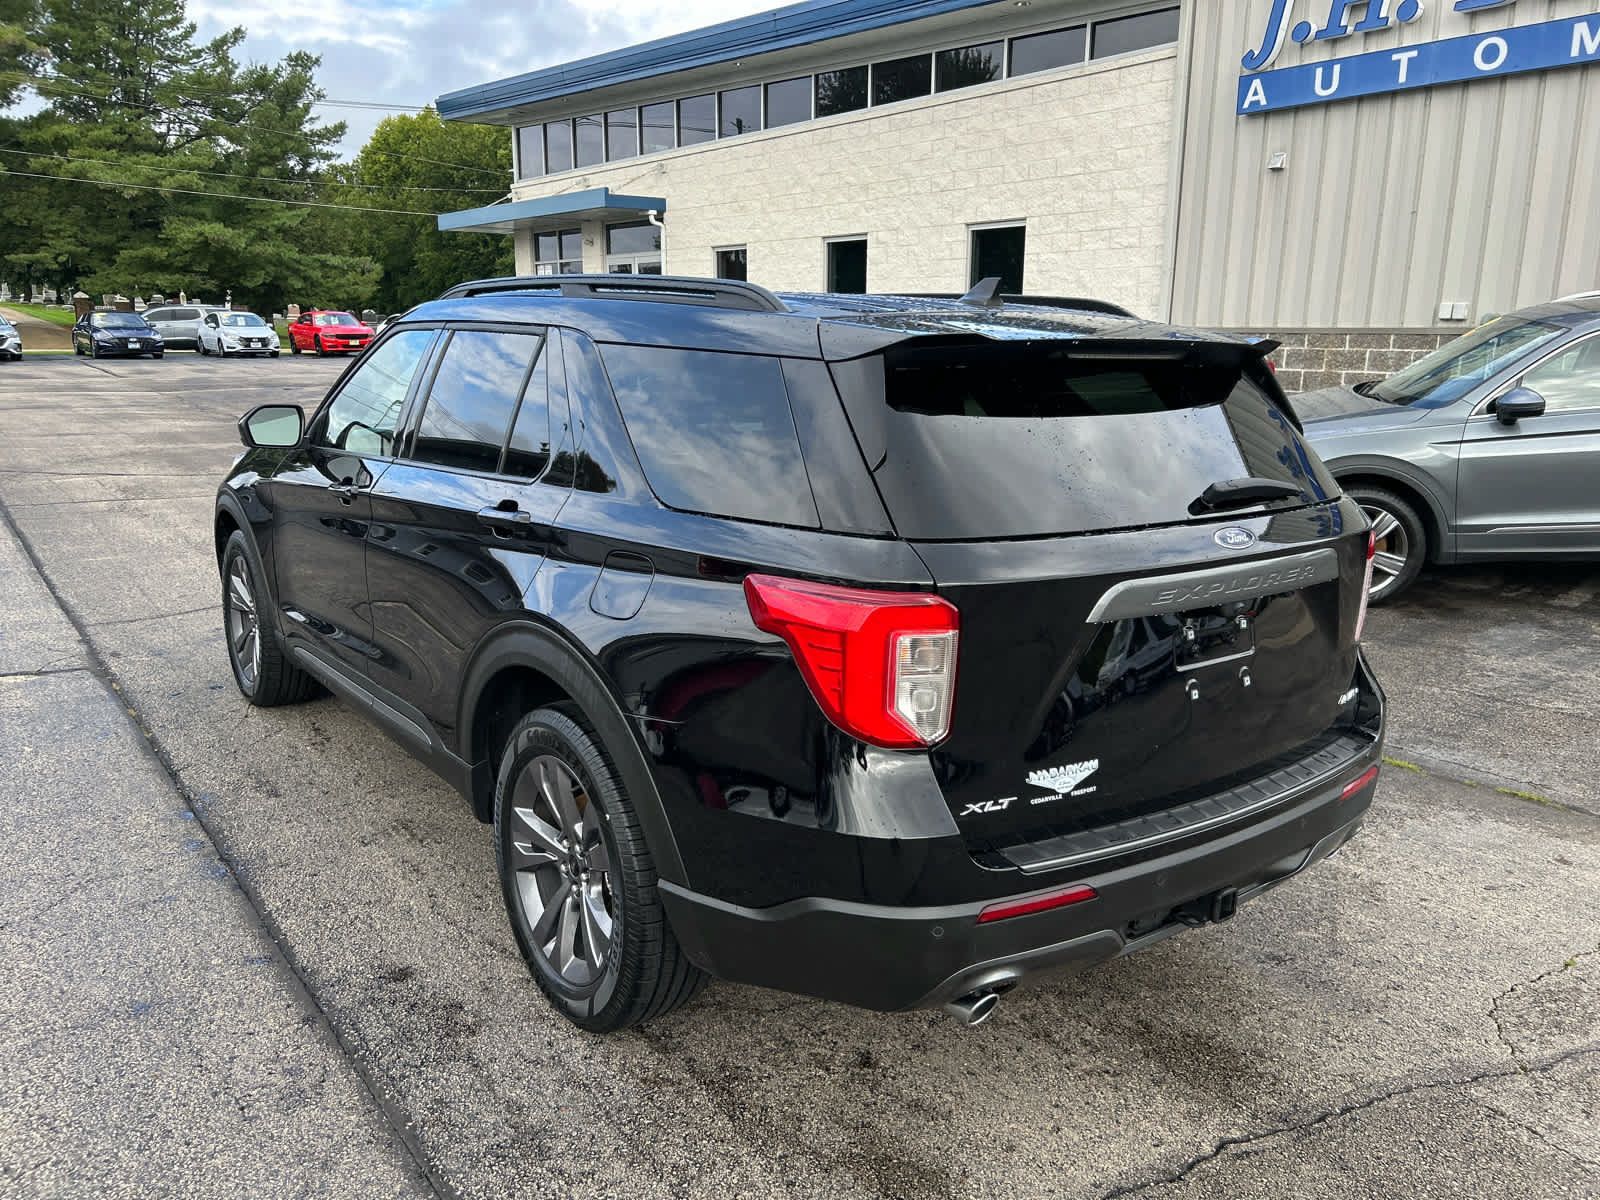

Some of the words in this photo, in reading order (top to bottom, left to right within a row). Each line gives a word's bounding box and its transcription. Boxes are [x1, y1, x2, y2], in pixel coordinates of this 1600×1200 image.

[1151, 565, 1315, 606] EXPLORER
[959, 796, 1018, 816] XLT
[1030, 793, 1063, 806] CEDARVILLE
[1070, 785, 1097, 797] FREEPORT
